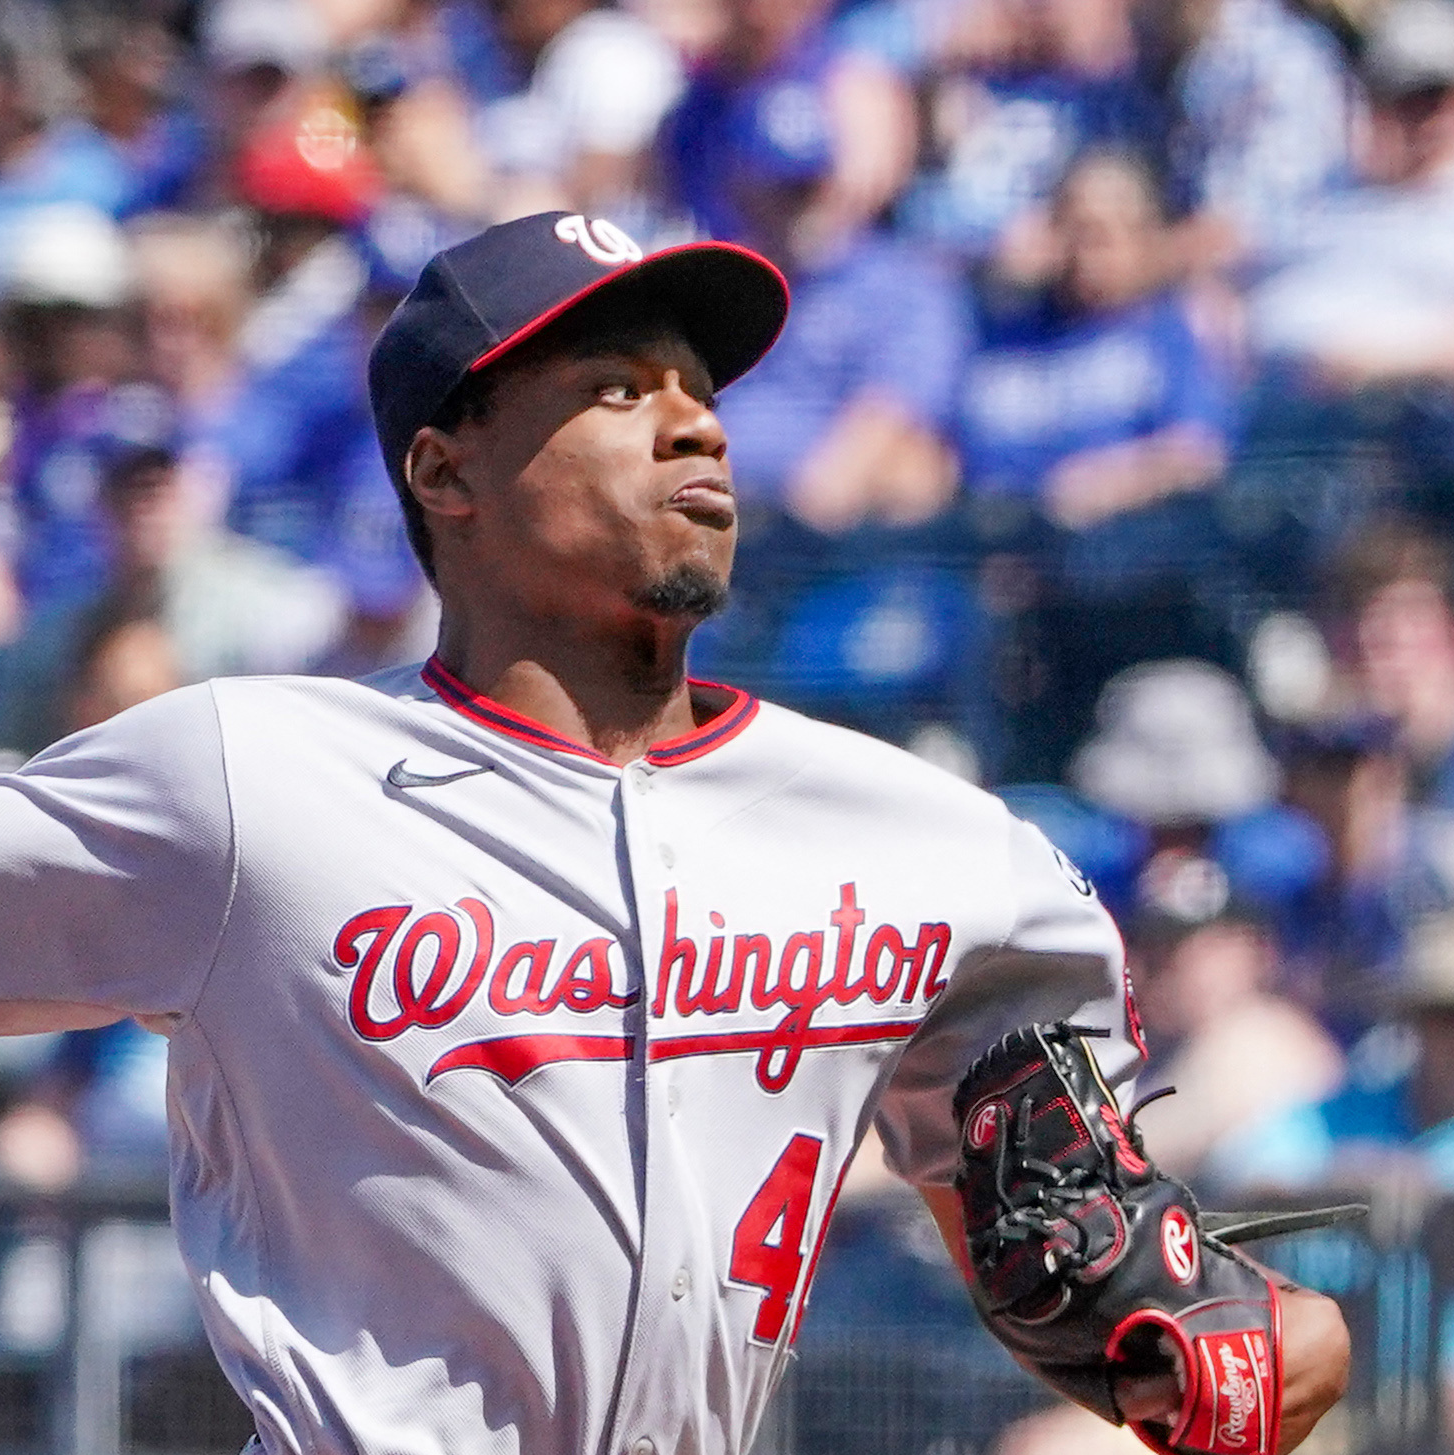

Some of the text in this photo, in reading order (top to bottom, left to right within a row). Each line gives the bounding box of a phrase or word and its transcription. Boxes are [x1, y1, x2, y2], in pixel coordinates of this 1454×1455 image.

[553, 214, 644, 266] W
[333, 880, 952, 1095] Washington
[722, 1128, 853, 1348] 4
[1163, 1219, 1192, 1280] R
[1216, 1341, 1249, 1448] Rawlings
